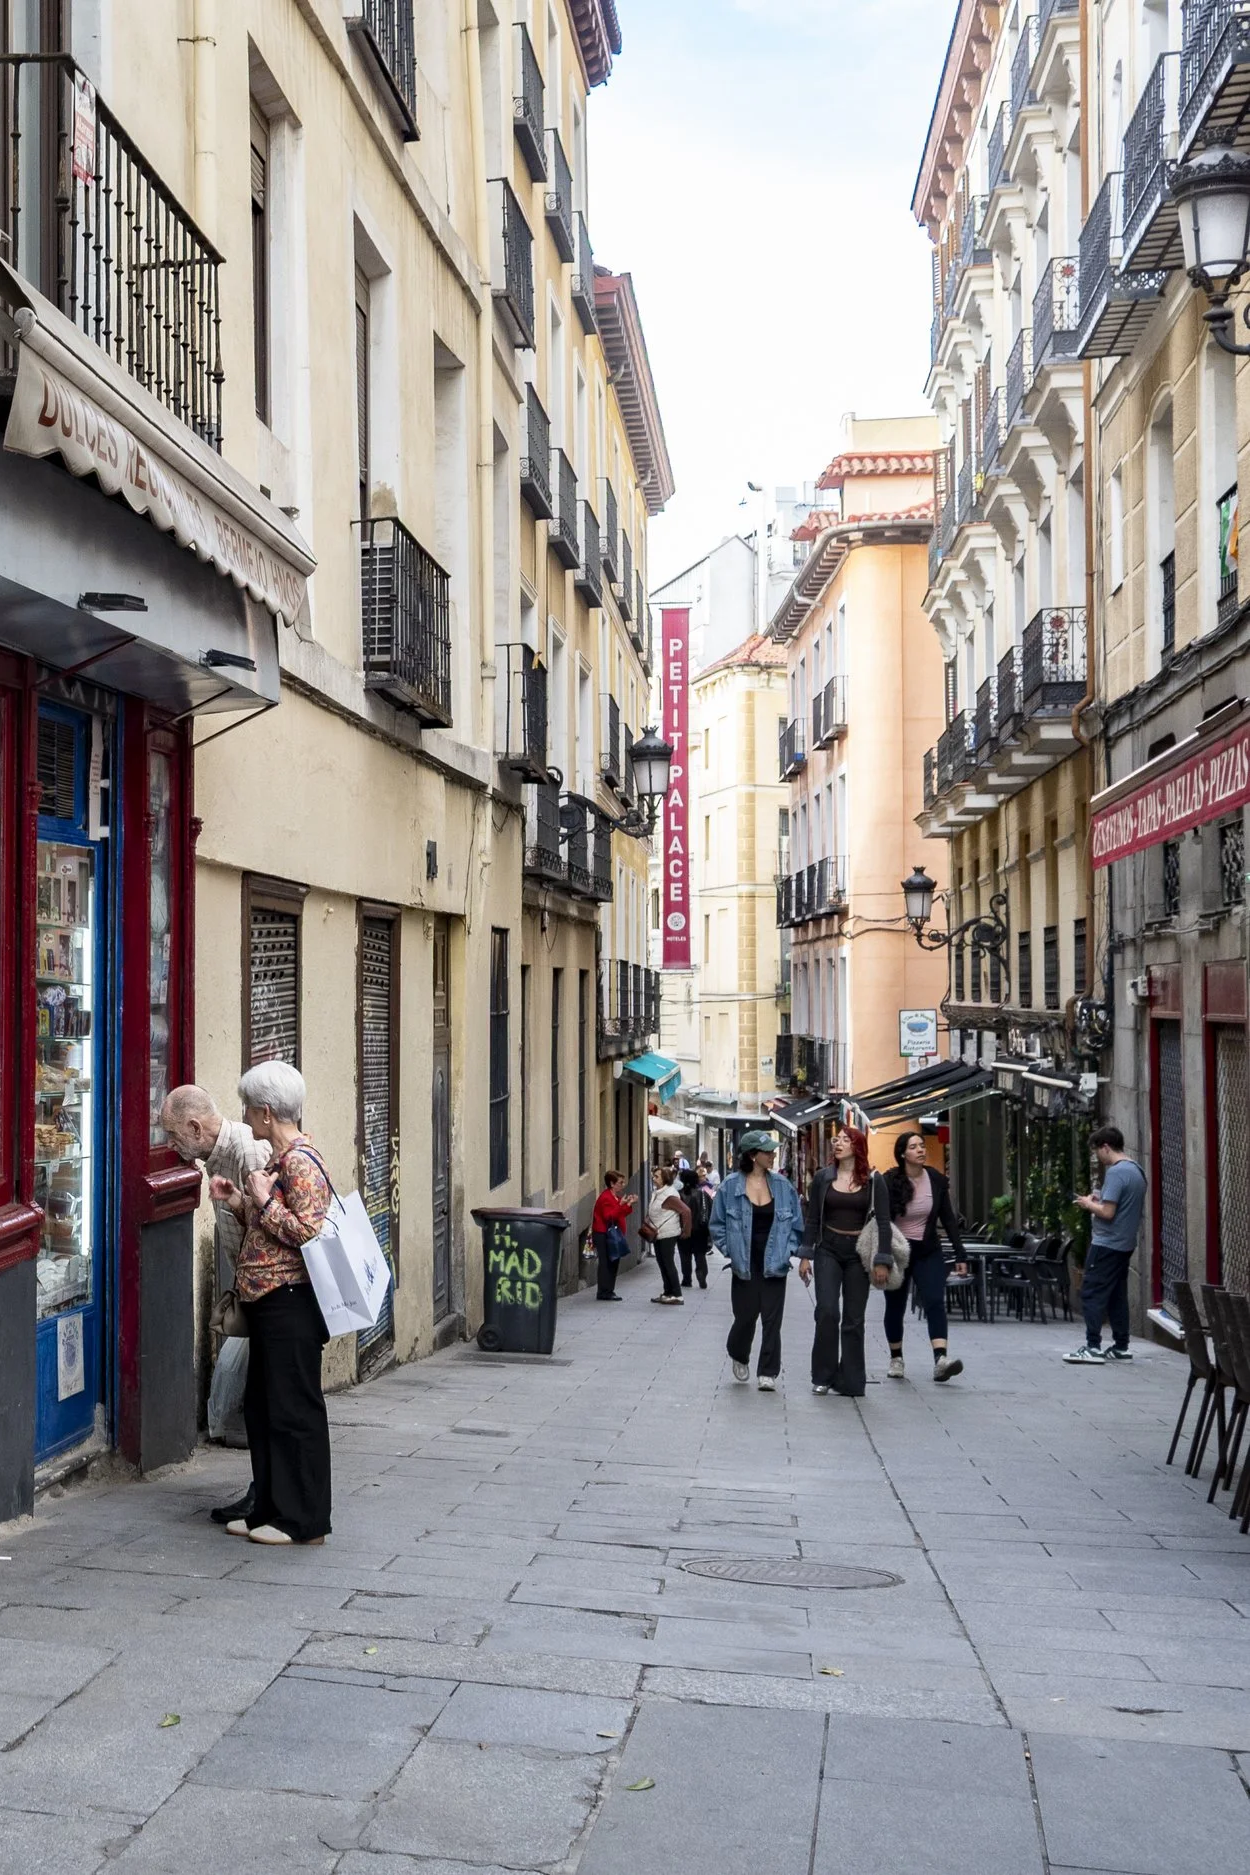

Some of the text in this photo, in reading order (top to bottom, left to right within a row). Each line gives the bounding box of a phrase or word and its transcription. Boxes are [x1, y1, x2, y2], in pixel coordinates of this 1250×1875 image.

[38, 369, 119, 469] DULCES
[668, 638, 684, 751] PETIT
[667, 764, 684, 902] PALACE
[1092, 738, 1249, 858] DESAYUNOS TAPAS PAELLAS PIZZAS
[489, 1248, 542, 1280] MAD
[496, 1276, 543, 1309] RID
